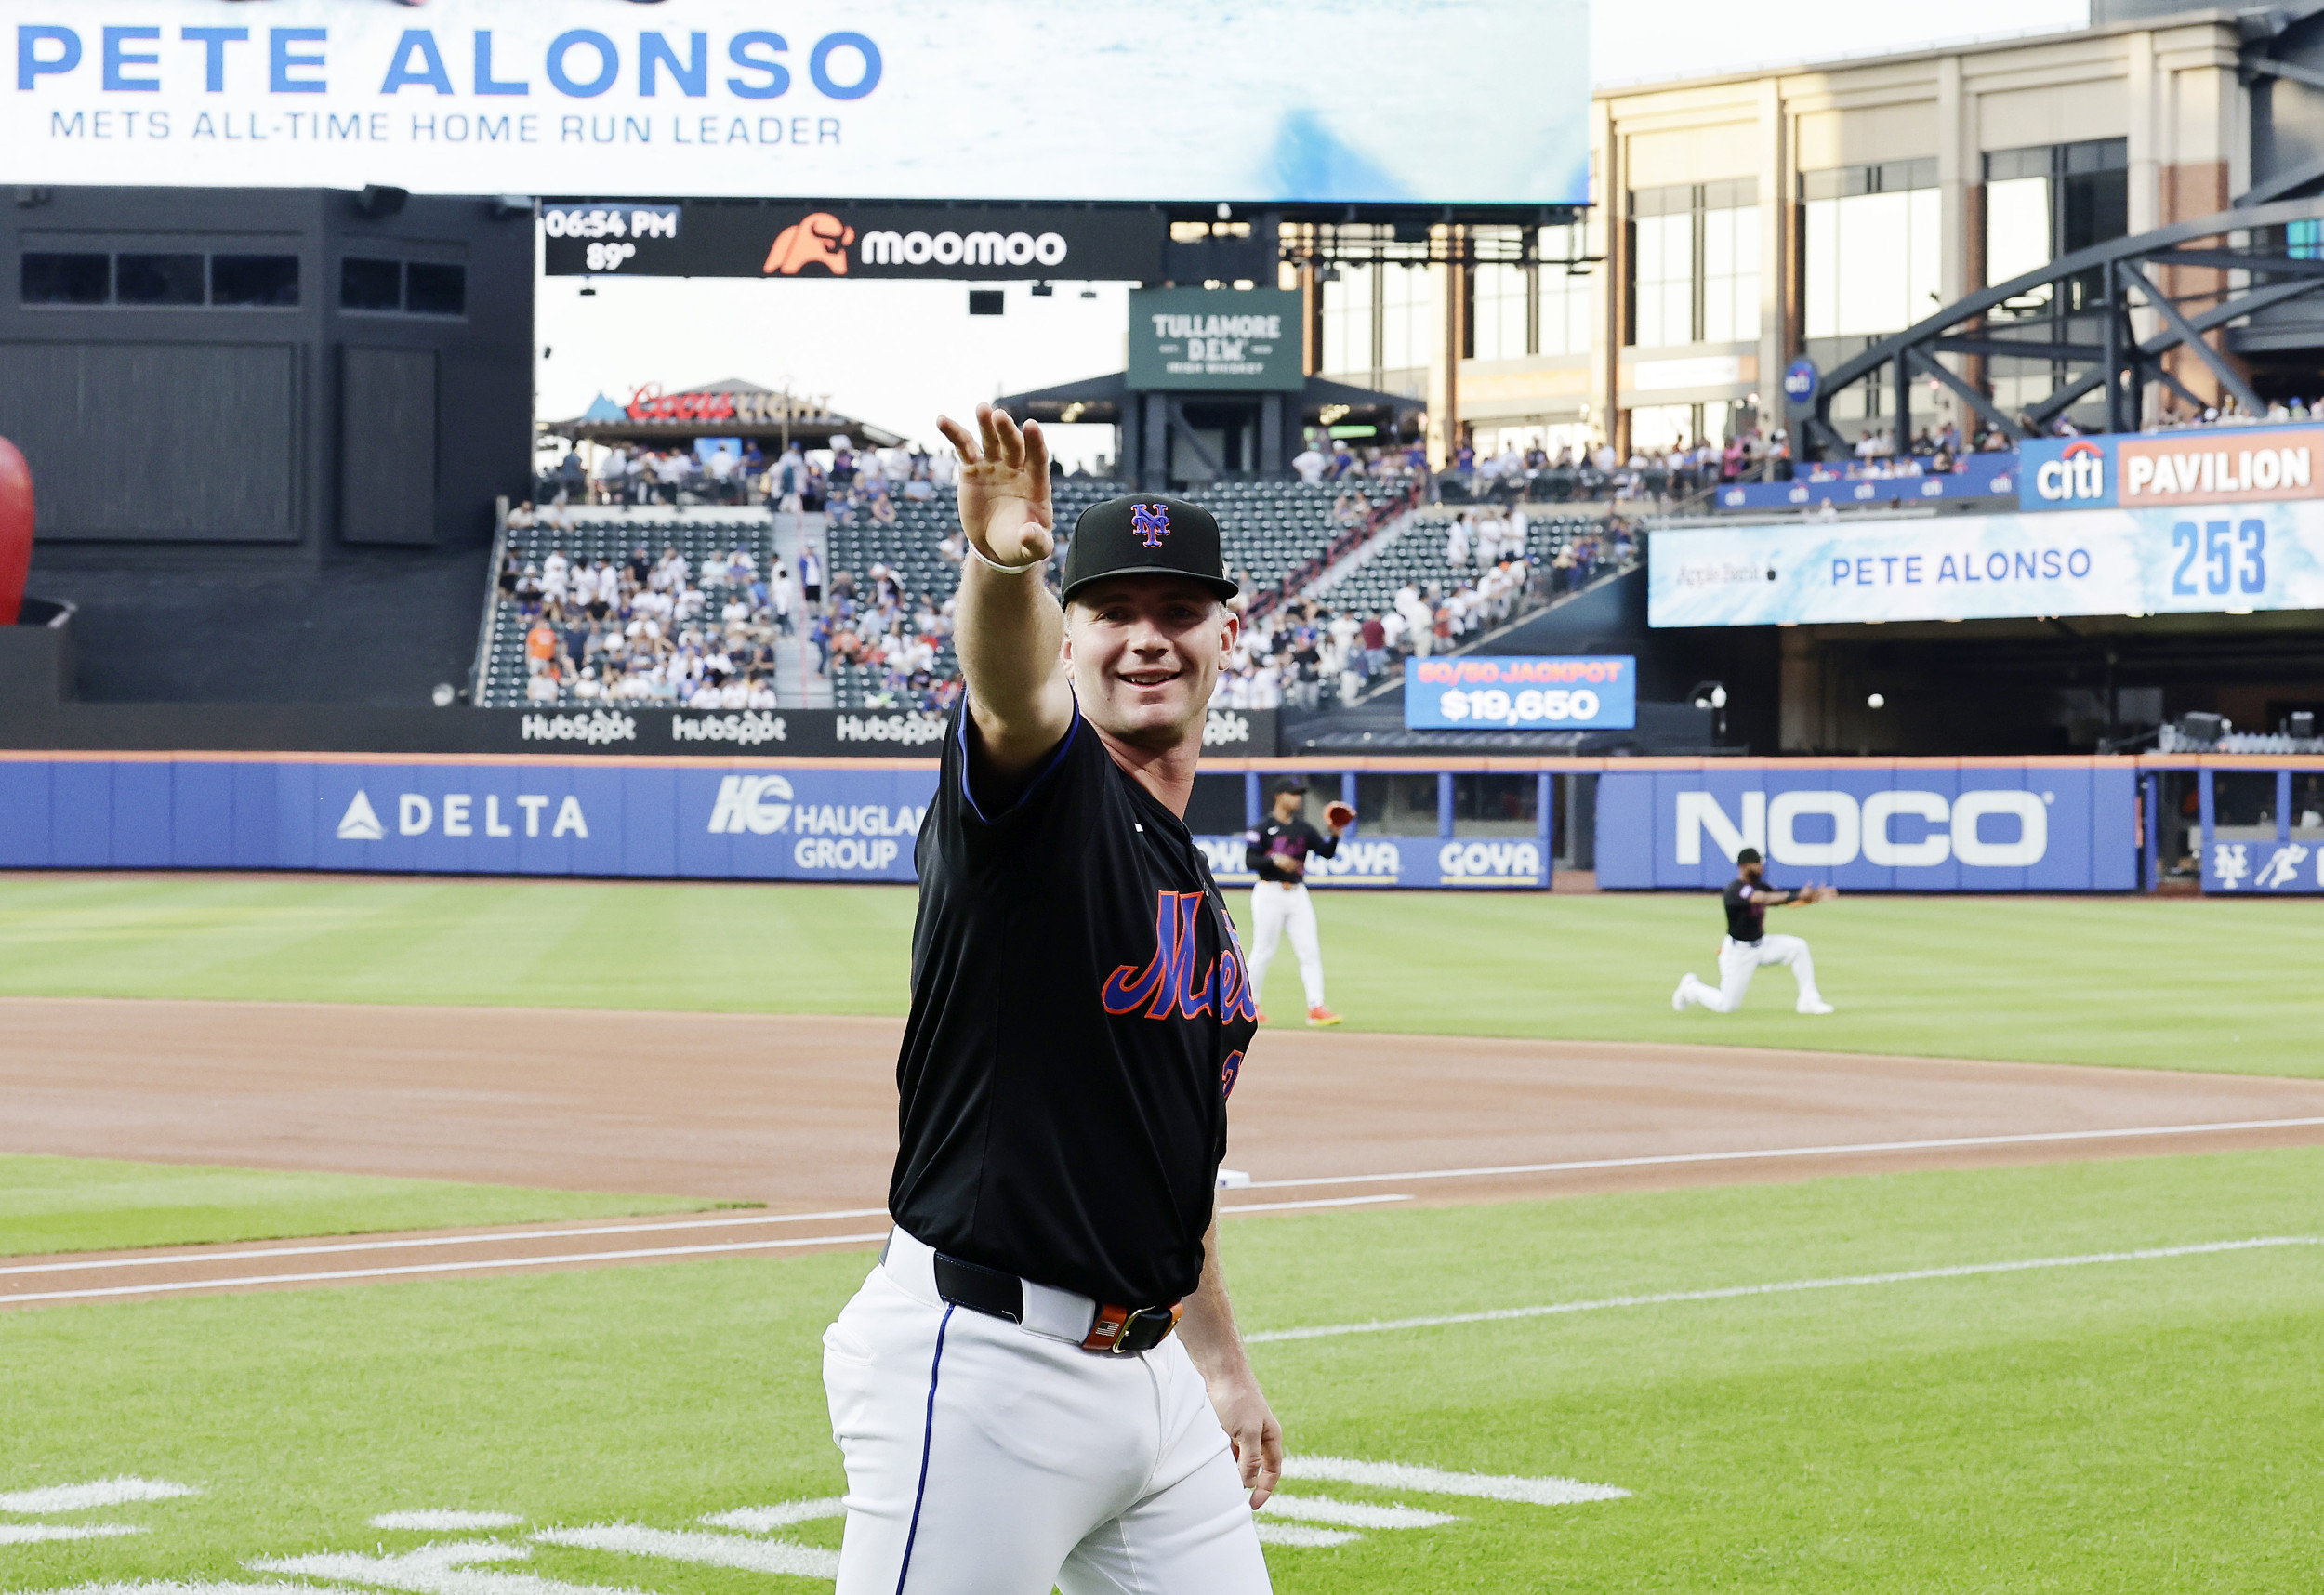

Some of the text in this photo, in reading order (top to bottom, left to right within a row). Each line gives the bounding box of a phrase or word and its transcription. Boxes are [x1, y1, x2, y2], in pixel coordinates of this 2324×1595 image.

[16, 25, 884, 100] PETE ALONSO
[50, 110, 841, 146] METS ALL-TIME HOME RUN LEADER
[545, 209, 677, 239] 06:54 PM
[861, 231, 1067, 266] moomoo
[1152, 313, 1281, 339] TULLAMORE
[2036, 446, 2312, 500] citi PAVILION
[1831, 548, 2091, 587] PETE ALONSO
[2172, 519, 2265, 596] 253
[1417, 661, 1623, 686] 50/50 JACKPOT
[1440, 688, 1600, 726] $19,650
[522, 708, 637, 745] HubSpot
[672, 709, 786, 745] HubSpot
[399, 793, 589, 838] DELTA
[707, 776, 794, 835] HG
[794, 804, 929, 836] HAUGLA
[1675, 790, 2047, 867] NOCO
[794, 837, 899, 870] GROUP
[1439, 842, 1539, 877] GOYA
[1102, 890, 1255, 1025] Met
